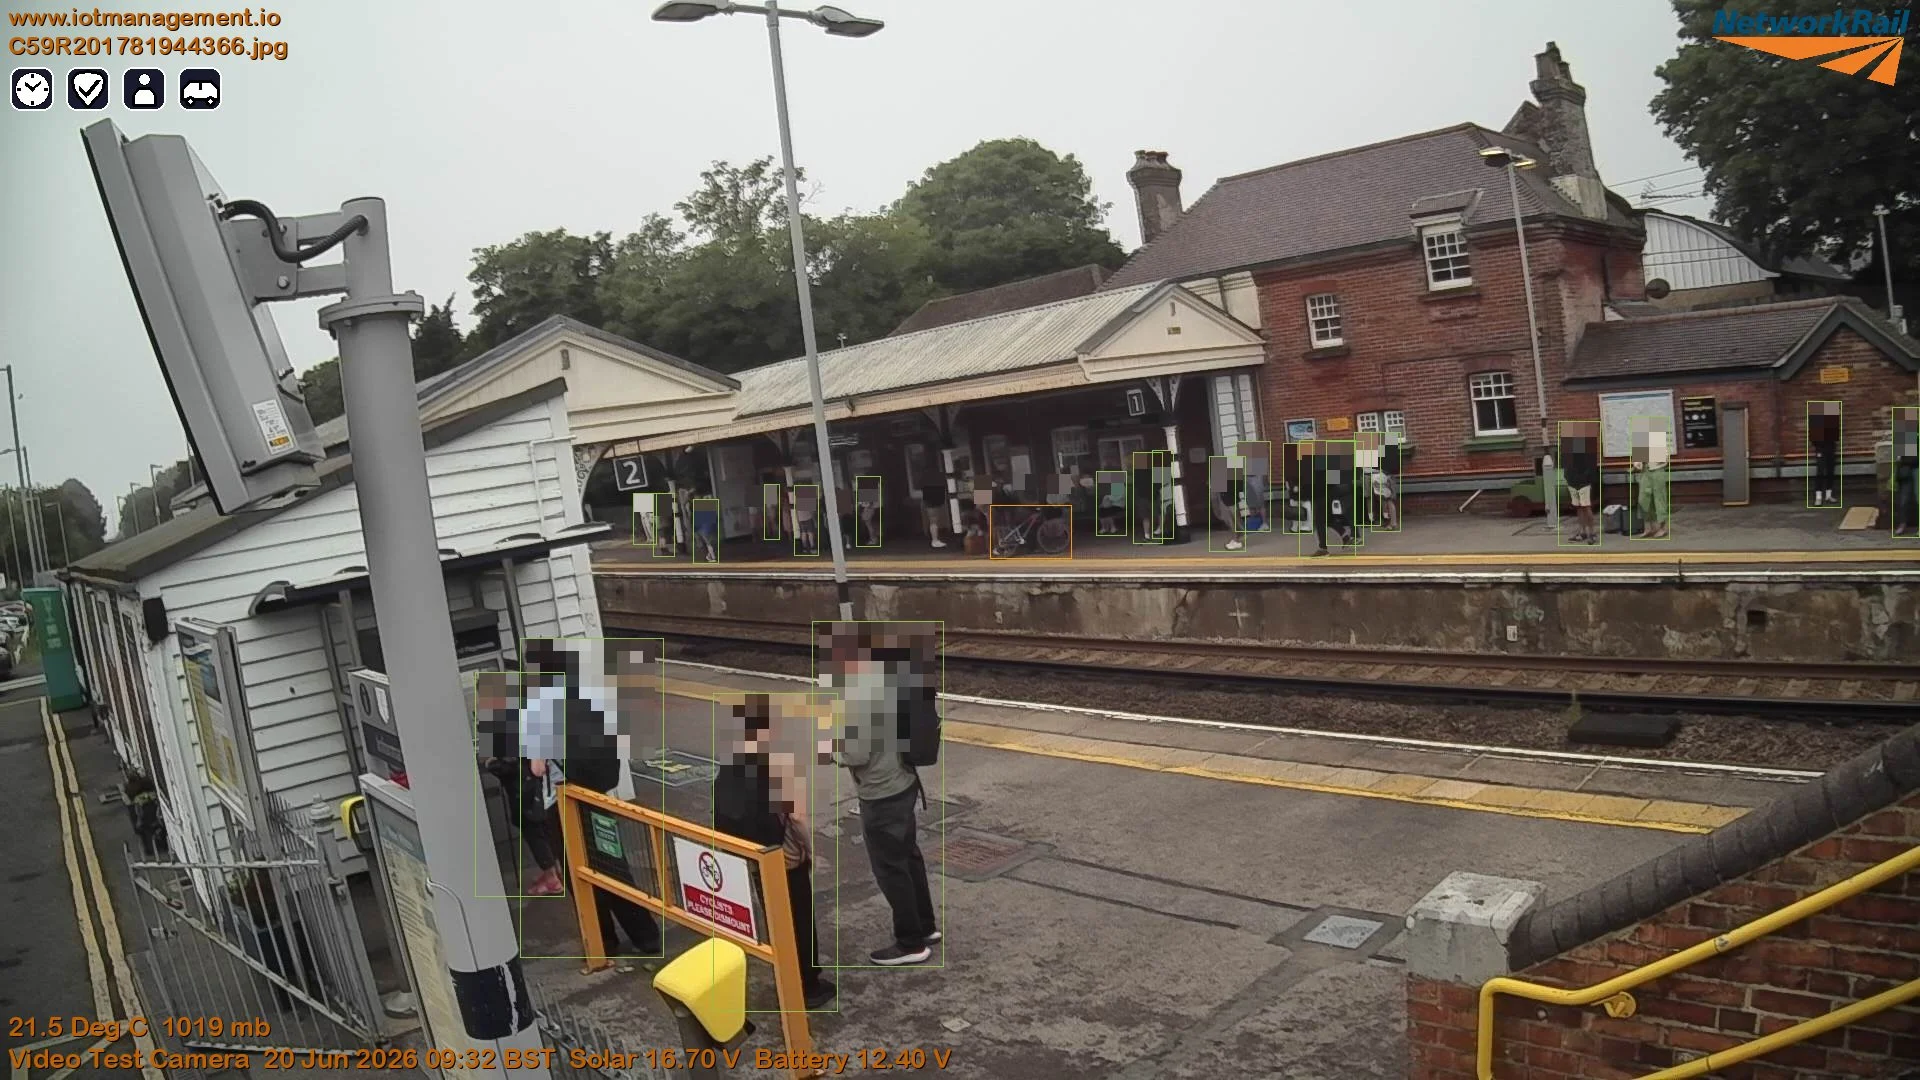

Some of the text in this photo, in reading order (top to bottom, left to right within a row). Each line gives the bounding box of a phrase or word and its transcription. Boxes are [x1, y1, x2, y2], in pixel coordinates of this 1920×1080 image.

[1132, 395, 1140, 412] 1
[622, 460, 641, 485] 2
[699, 894, 734, 915] CYCLISTS
[687, 900, 751, 934] PLEASE DISMOUNT
